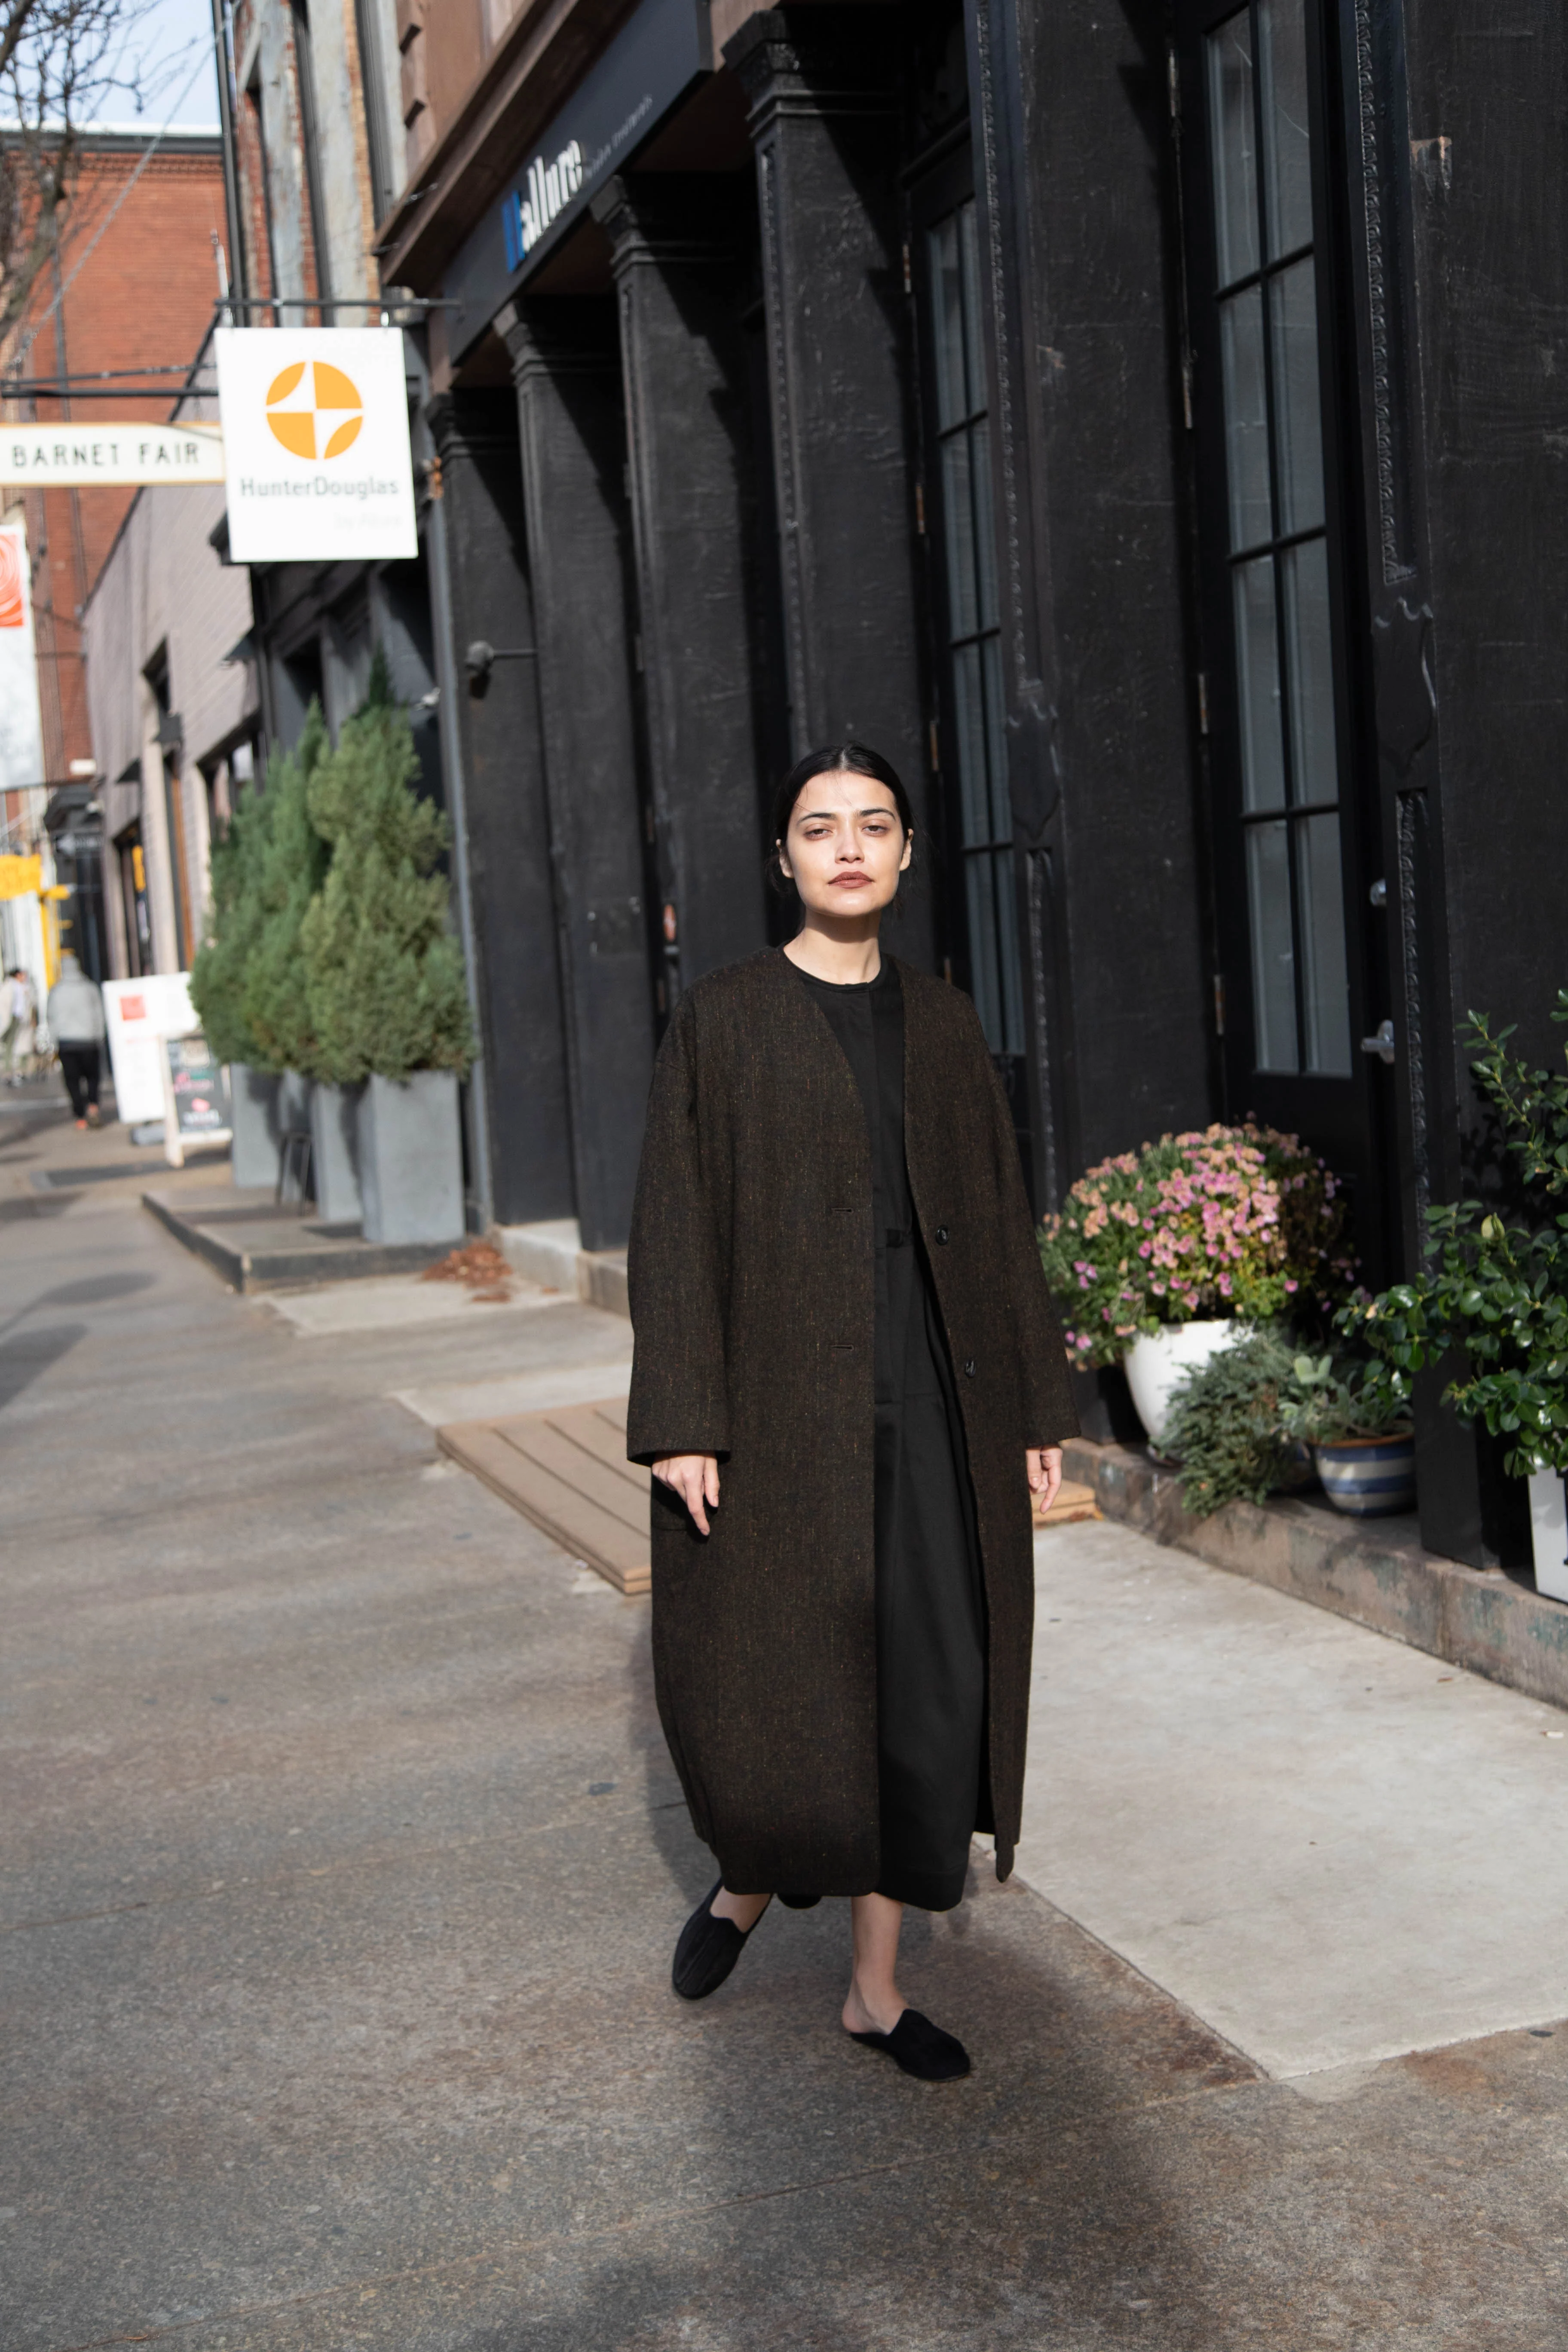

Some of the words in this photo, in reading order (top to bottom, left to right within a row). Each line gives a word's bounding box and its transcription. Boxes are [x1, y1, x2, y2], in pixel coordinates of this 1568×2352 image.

[12, 443, 119, 466] BARNET
[139, 442, 199, 464] FAIR
[240, 476, 399, 500] HunterDouglas
